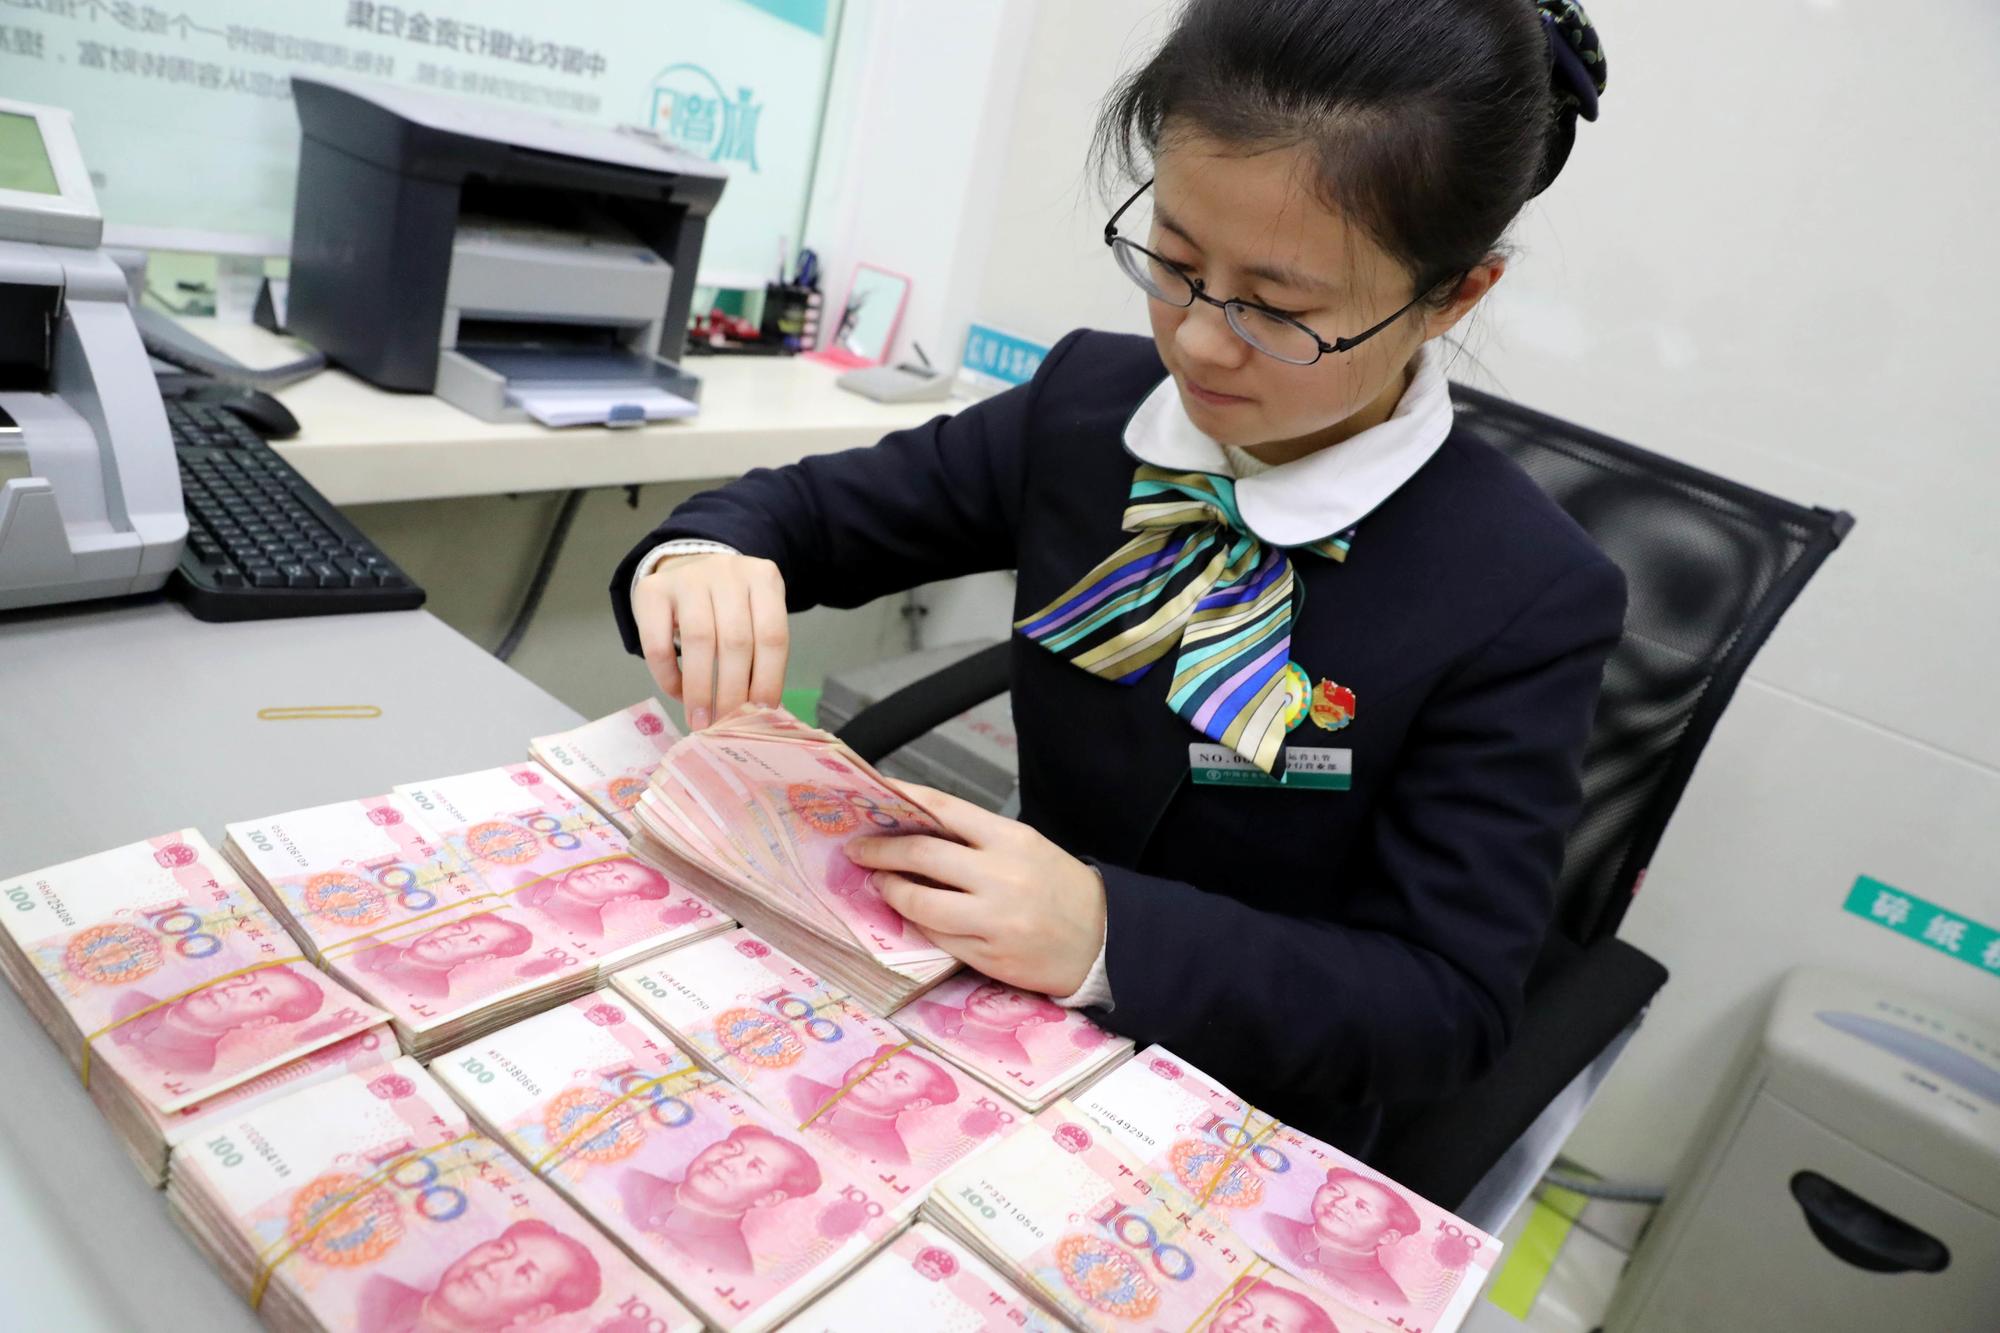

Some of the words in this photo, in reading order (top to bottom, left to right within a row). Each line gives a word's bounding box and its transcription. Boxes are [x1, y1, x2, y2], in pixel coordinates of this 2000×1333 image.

[549, 745, 575, 767] 100
[409, 790, 435, 811] 100
[246, 829, 274, 852] 100
[4, 884, 36, 912] 100
[680, 896, 713, 920] 100
[143, 900, 224, 960] 100
[544, 944, 579, 967] 100
[635, 975, 668, 999] 100
[331, 1004, 368, 1026] 100
[759, 988, 844, 1043] 100
[458, 1055, 496, 1085] 100
[974, 1095, 1014, 1124] 100
[205, 1134, 245, 1169] 100
[840, 1183, 883, 1218] 100
[958, 1186, 997, 1220] 100
[1093, 1199, 1195, 1282] 100
[1436, 1219, 1481, 1249] 100
[616, 1295, 669, 1333] 100
